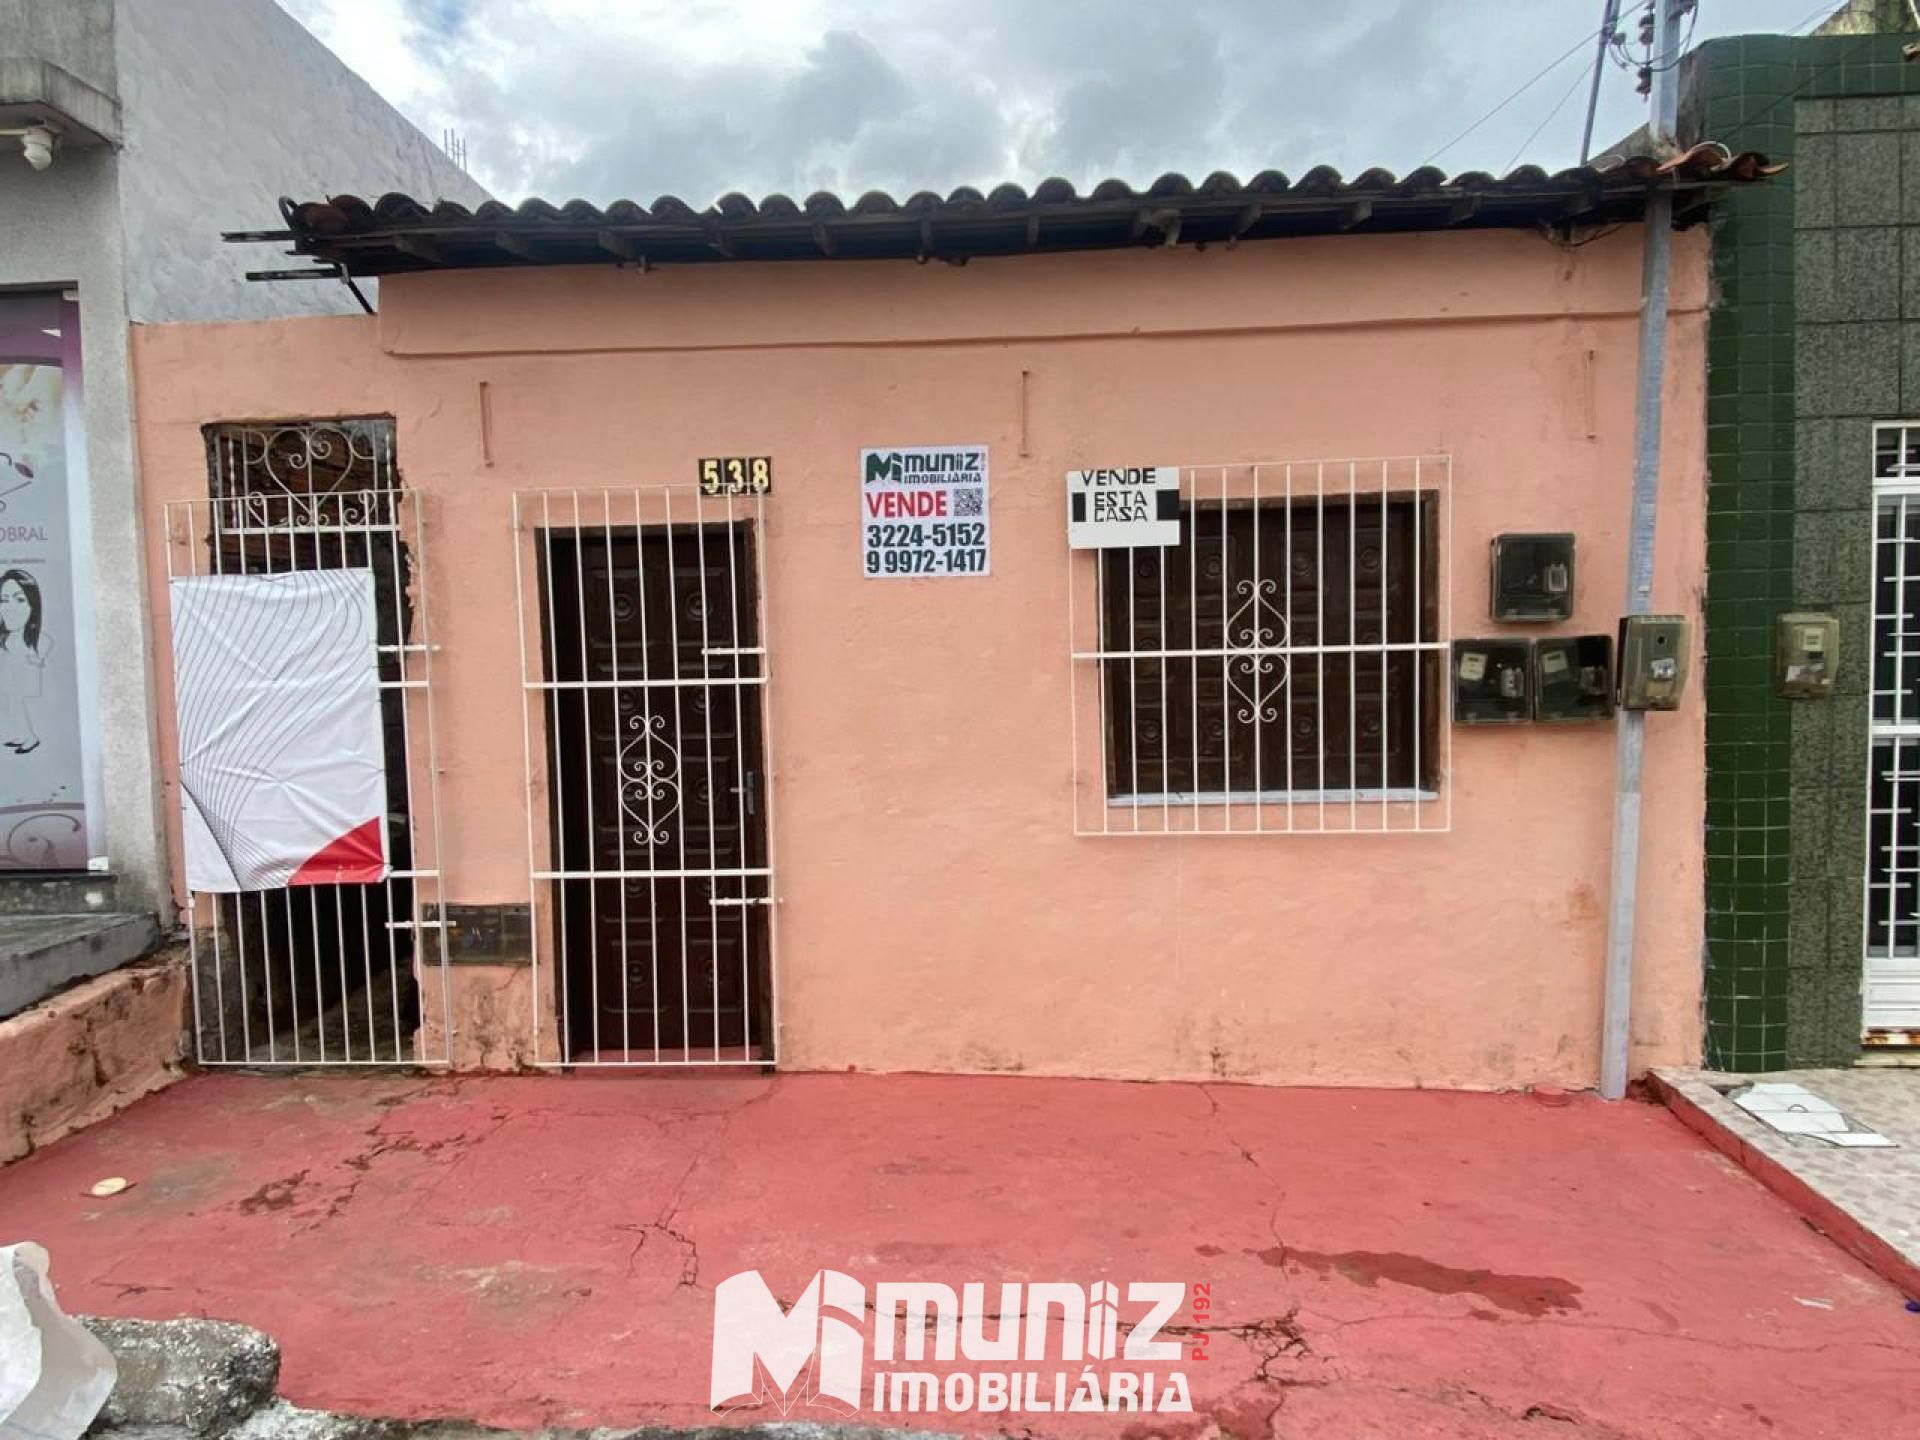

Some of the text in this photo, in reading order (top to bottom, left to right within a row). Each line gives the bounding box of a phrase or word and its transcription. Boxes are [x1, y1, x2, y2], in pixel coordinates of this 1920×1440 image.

[704, 459, 769, 494] 538
[1081, 467, 1156, 486] VENDE
[865, 490, 947, 518] VENDE
[1094, 490, 1148, 507] ESTA
[1094, 506, 1148, 522] CASA
[867, 522, 985, 548] 3224-5152
[866, 548, 986, 573] 9 9972-1417
